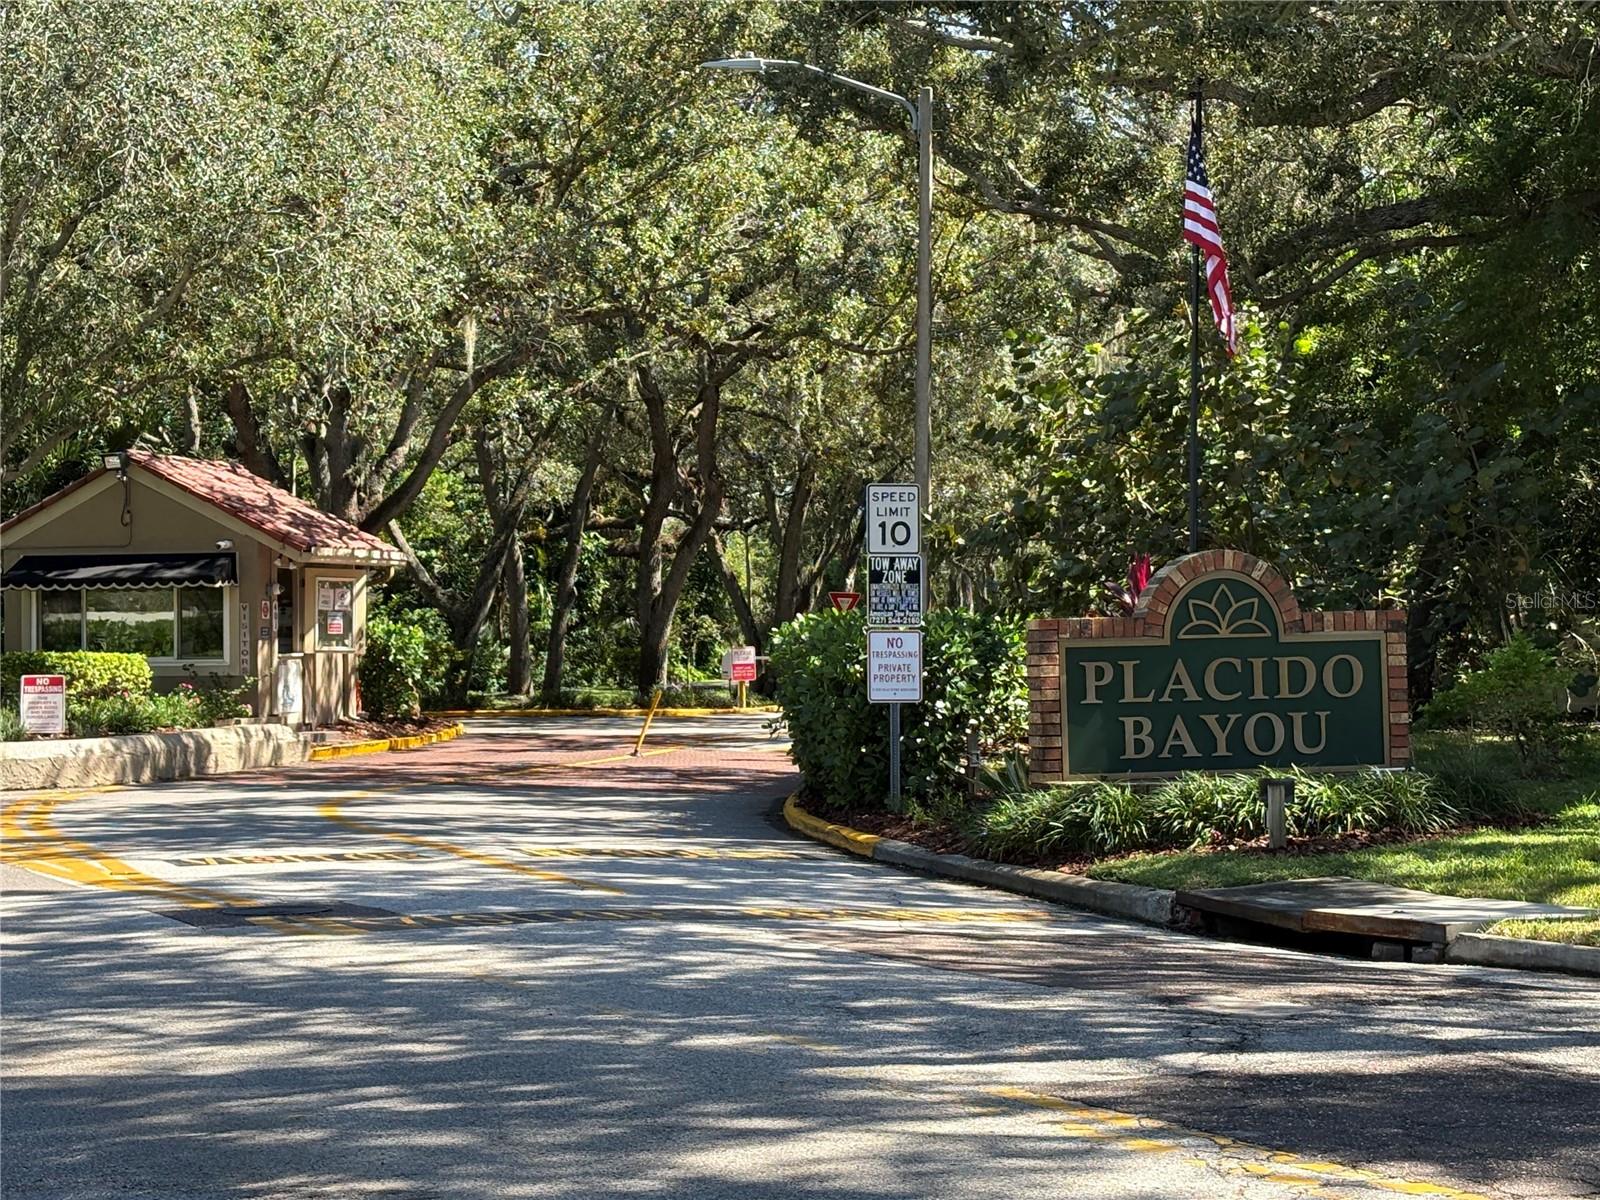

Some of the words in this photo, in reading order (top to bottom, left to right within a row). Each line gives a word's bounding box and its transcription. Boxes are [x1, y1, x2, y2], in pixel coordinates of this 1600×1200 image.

[872, 491, 916, 502] SPEED
[876, 507, 911, 517] LIMIT
[878, 521, 911, 546] 10
[870, 557, 890, 571] TOW
[893, 557, 919, 571] AWAY
[882, 570, 907, 584] ZONE
[887, 637, 903, 649] NO
[878, 663, 911, 672] PRIVATE
[36, 678, 50, 686] NO
[873, 674, 916, 683] PROPERTY
[1079, 654, 1364, 705] PLACIDO
[1119, 711, 1331, 760] BAYOU
